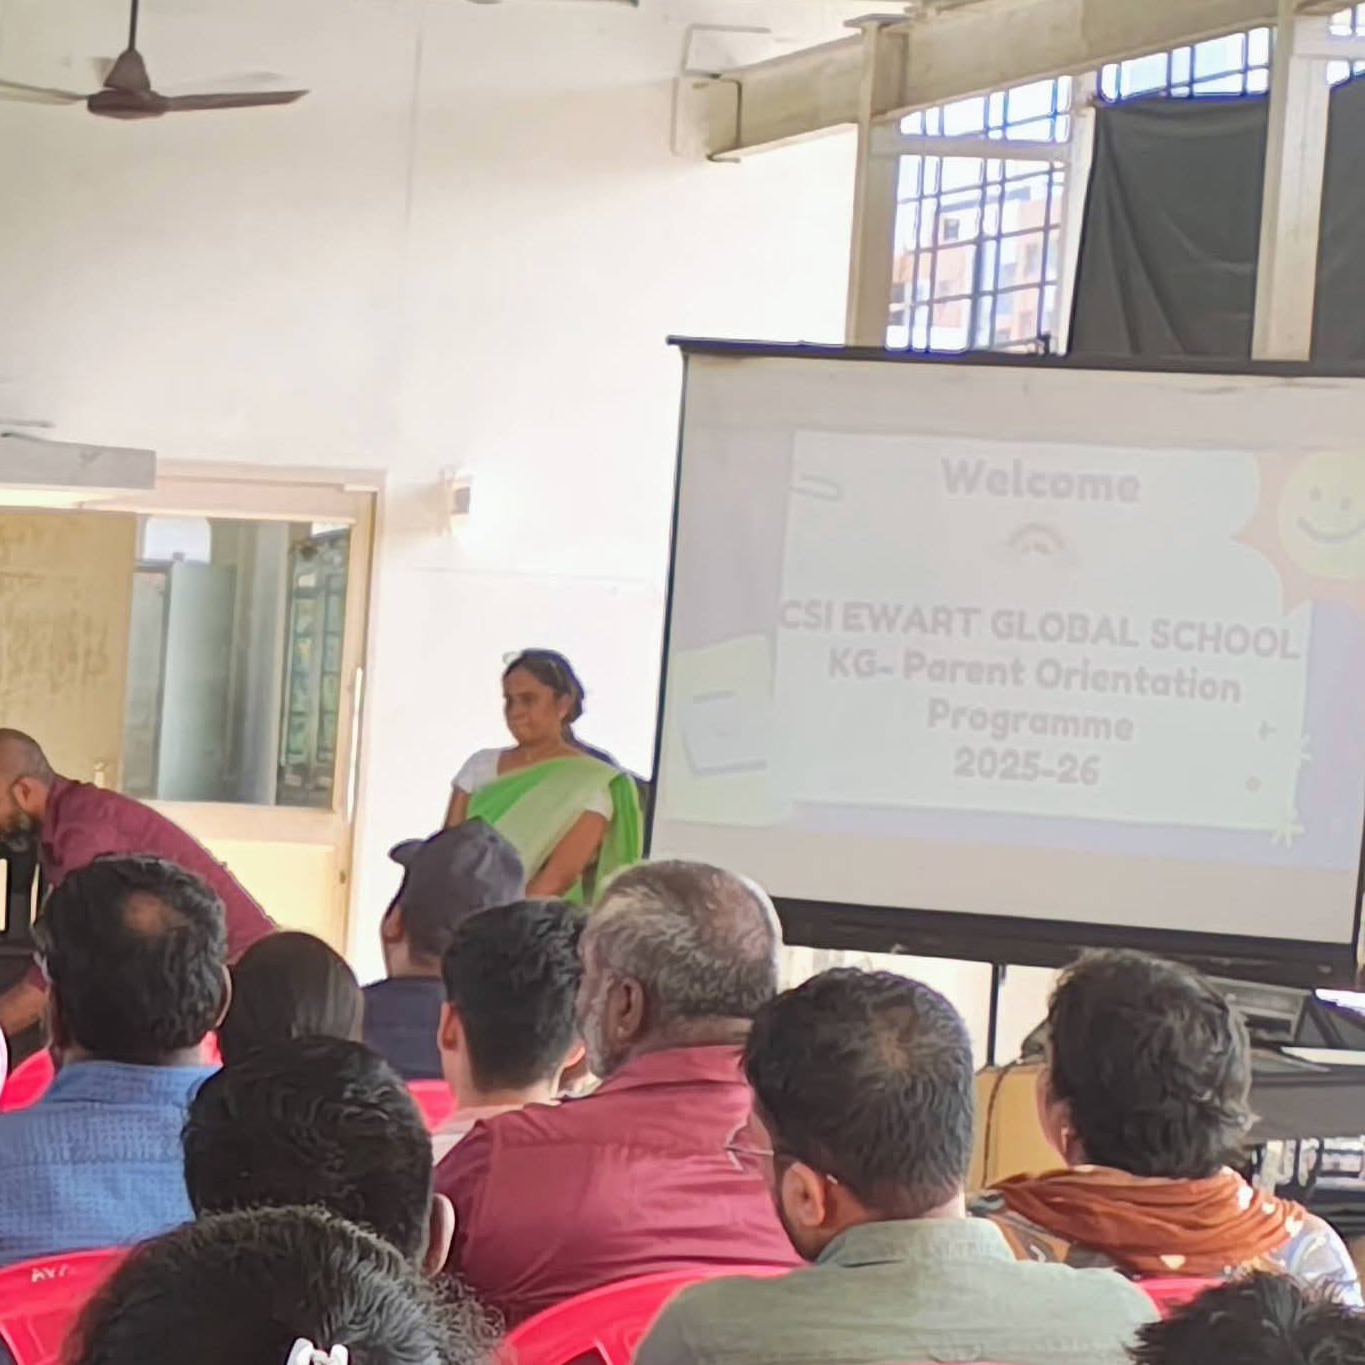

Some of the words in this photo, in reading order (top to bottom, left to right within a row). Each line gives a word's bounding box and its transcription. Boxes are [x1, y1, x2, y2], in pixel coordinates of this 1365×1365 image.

[940, 457, 1142, 503] Welcome
[780, 599, 832, 632] CSI
[842, 602, 982, 639] EWART
[990, 608, 1139, 649] GLOBAL
[1149, 617, 1301, 661] SCHOOL
[828, 647, 895, 678] KG-
[903, 650, 1025, 686] Parent
[1035, 657, 1243, 703] Orientation
[926, 697, 1135, 742] Programme
[952, 746, 1103, 787] 2025-26
